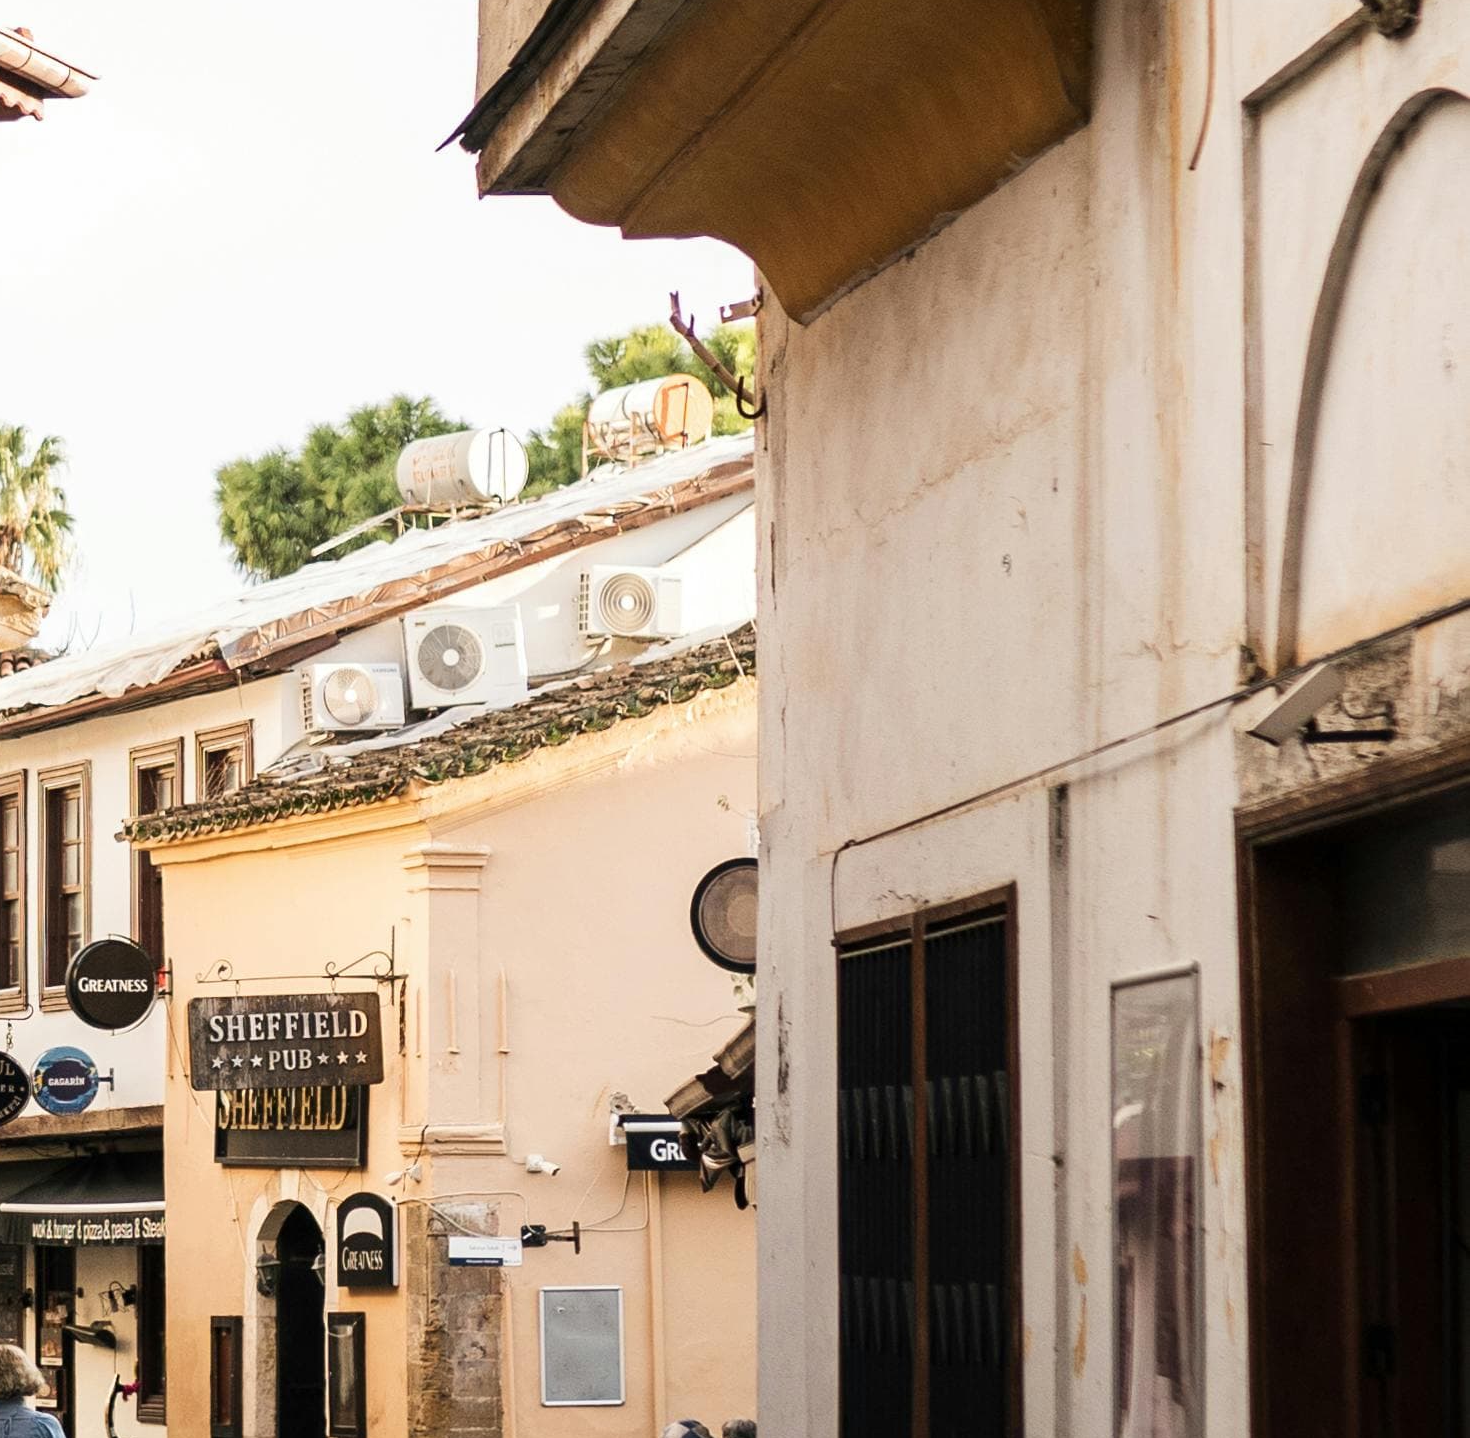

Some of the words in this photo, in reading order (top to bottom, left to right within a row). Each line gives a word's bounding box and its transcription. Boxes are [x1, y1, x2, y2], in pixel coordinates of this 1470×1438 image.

[78, 977, 148, 993] GREATNESS
[209, 1010, 368, 1043] SHEFFIELD
[268, 1049, 313, 1071] PUB
[218, 1086, 348, 1131] SHEFFIELD
[83, 1220, 103, 1244] pizza
[111, 1220, 133, 1243] pasta
[342, 1246, 383, 1271] GREATNESS
